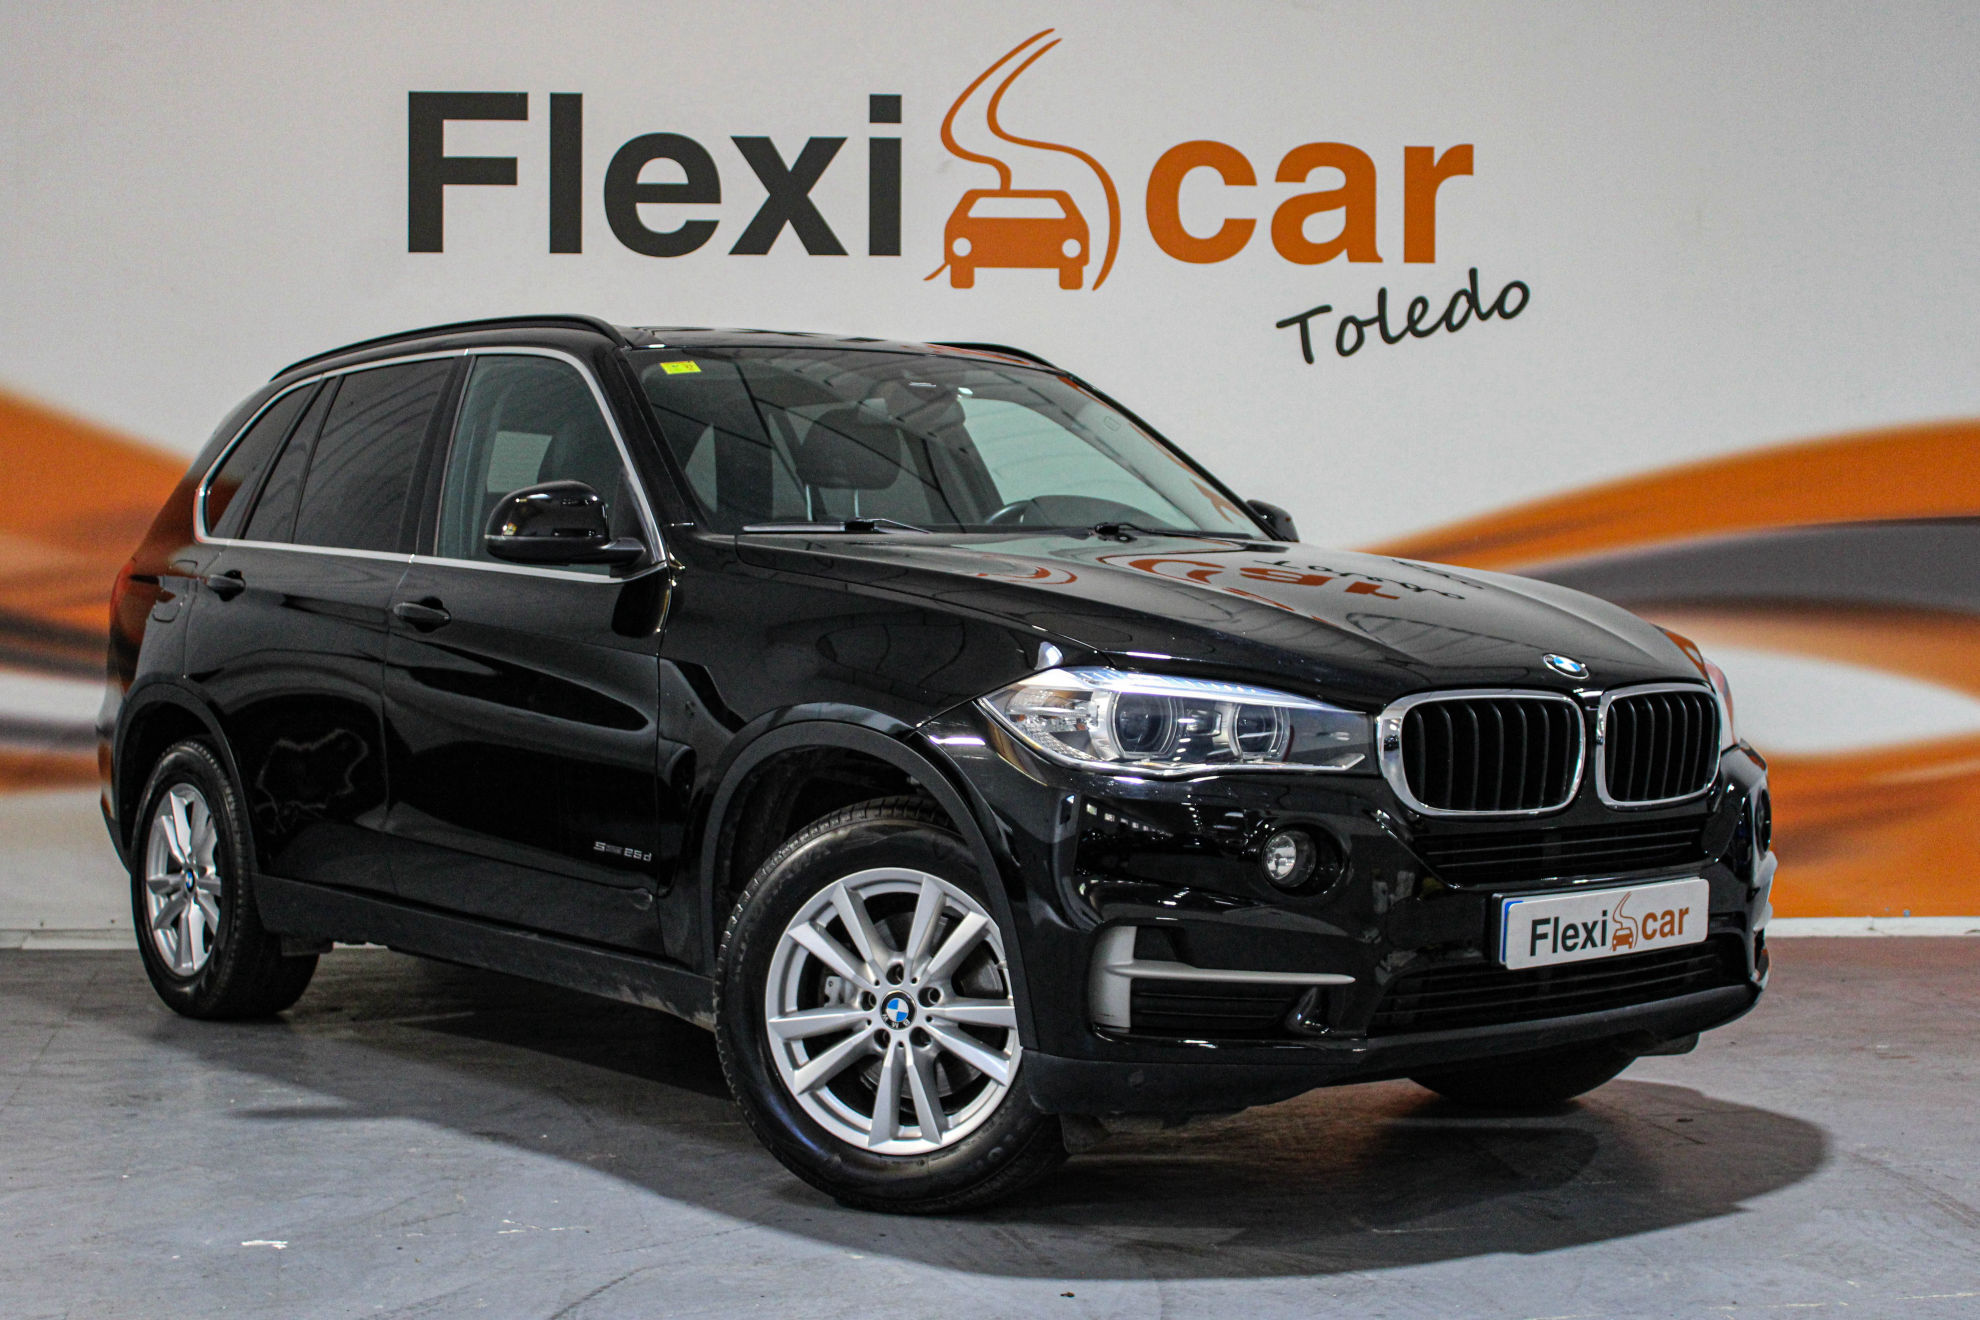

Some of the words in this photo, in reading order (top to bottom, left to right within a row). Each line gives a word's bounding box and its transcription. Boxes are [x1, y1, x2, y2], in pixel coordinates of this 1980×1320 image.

[407, 91, 902, 257] Flexi
[1146, 140, 1474, 264] car
[1276, 267, 1530, 365] Toledo
[1529, 909, 1608, 957] Flexi
[1641, 906, 1690, 941] car
